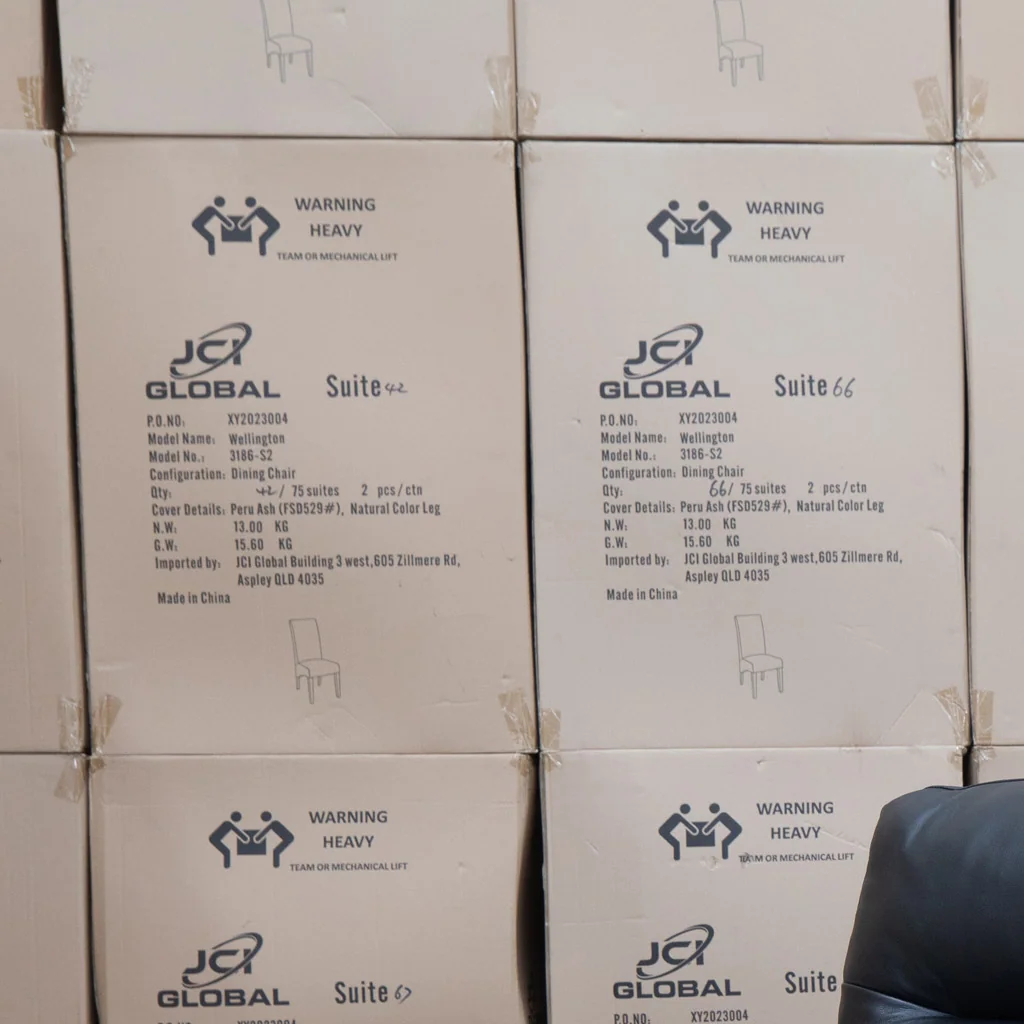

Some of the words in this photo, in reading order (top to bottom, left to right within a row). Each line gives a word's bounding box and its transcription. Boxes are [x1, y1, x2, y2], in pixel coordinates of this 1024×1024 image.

[294, 198, 376, 211] WARNING
[746, 202, 824, 214] WARNING
[310, 224, 362, 237] HEAVY
[760, 227, 811, 240] HEAVY
[278, 252, 303, 260] TEAM
[305, 252, 318, 260] OR
[320, 252, 378, 261] MECHANICAL
[755, 255, 767, 263] OR
[146, 380, 281, 400] GLOBAL
[326, 374, 381, 398] Suite
[599, 380, 730, 399] GLOBAL
[775, 374, 827, 397] Suite
[833, 377, 855, 398] 66
[228, 412, 288, 425] XY2023004
[679, 412, 737, 424] XY2023004
[148, 432, 178, 445] Model
[229, 433, 284, 446] Wellington
[601, 432, 631, 444] Model
[680, 432, 734, 445] Wellington
[602, 449, 632, 462] Model
[680, 448, 722, 460] 3186-S2
[682, 466, 714, 480] Dining
[717, 466, 744, 478] Chair
[740, 483, 752, 494] 75
[755, 482, 786, 494] suites
[808, 482, 814, 494] 2
[604, 502, 632, 514] Cover
[680, 501, 703, 512] Peru
[706, 500, 724, 512] Ash
[797, 500, 834, 512] Natural
[838, 499, 864, 511] Color
[867, 499, 884, 513] Leg
[684, 518, 711, 530] 13.00
[723, 518, 736, 529] KG
[684, 536, 712, 548] 15.60
[726, 535, 740, 547] KG
[606, 554, 652, 568] Imported
[684, 553, 699, 565] JCI
[702, 552, 734, 564] Global
[738, 552, 779, 566] Building
[782, 552, 788, 564] 3
[841, 551, 883, 562] Zillmere
[886, 550, 902, 564] Rd,
[685, 570, 718, 584] Aspley
[722, 570, 740, 582] QLD
[744, 569, 770, 581] 4035
[158, 592, 185, 604] Made
[188, 592, 198, 604] in
[201, 592, 230, 604] China
[607, 588, 633, 600] Made
[637, 588, 646, 600] in
[649, 588, 678, 600] China
[756, 802, 833, 815] WARNING
[308, 810, 387, 824] WARNING
[771, 826, 821, 839] HEAVY
[324, 836, 374, 848] HEAVY
[780, 854, 836, 862] MECHANICAL
[391, 862, 408, 870] LIFT
[785, 970, 836, 994] Suite
[334, 981, 388, 1004] Suite
[613, 979, 742, 999] GLOBAL
[157, 988, 290, 1008] GLOBAL
[691, 1009, 748, 1023] XY2023004
